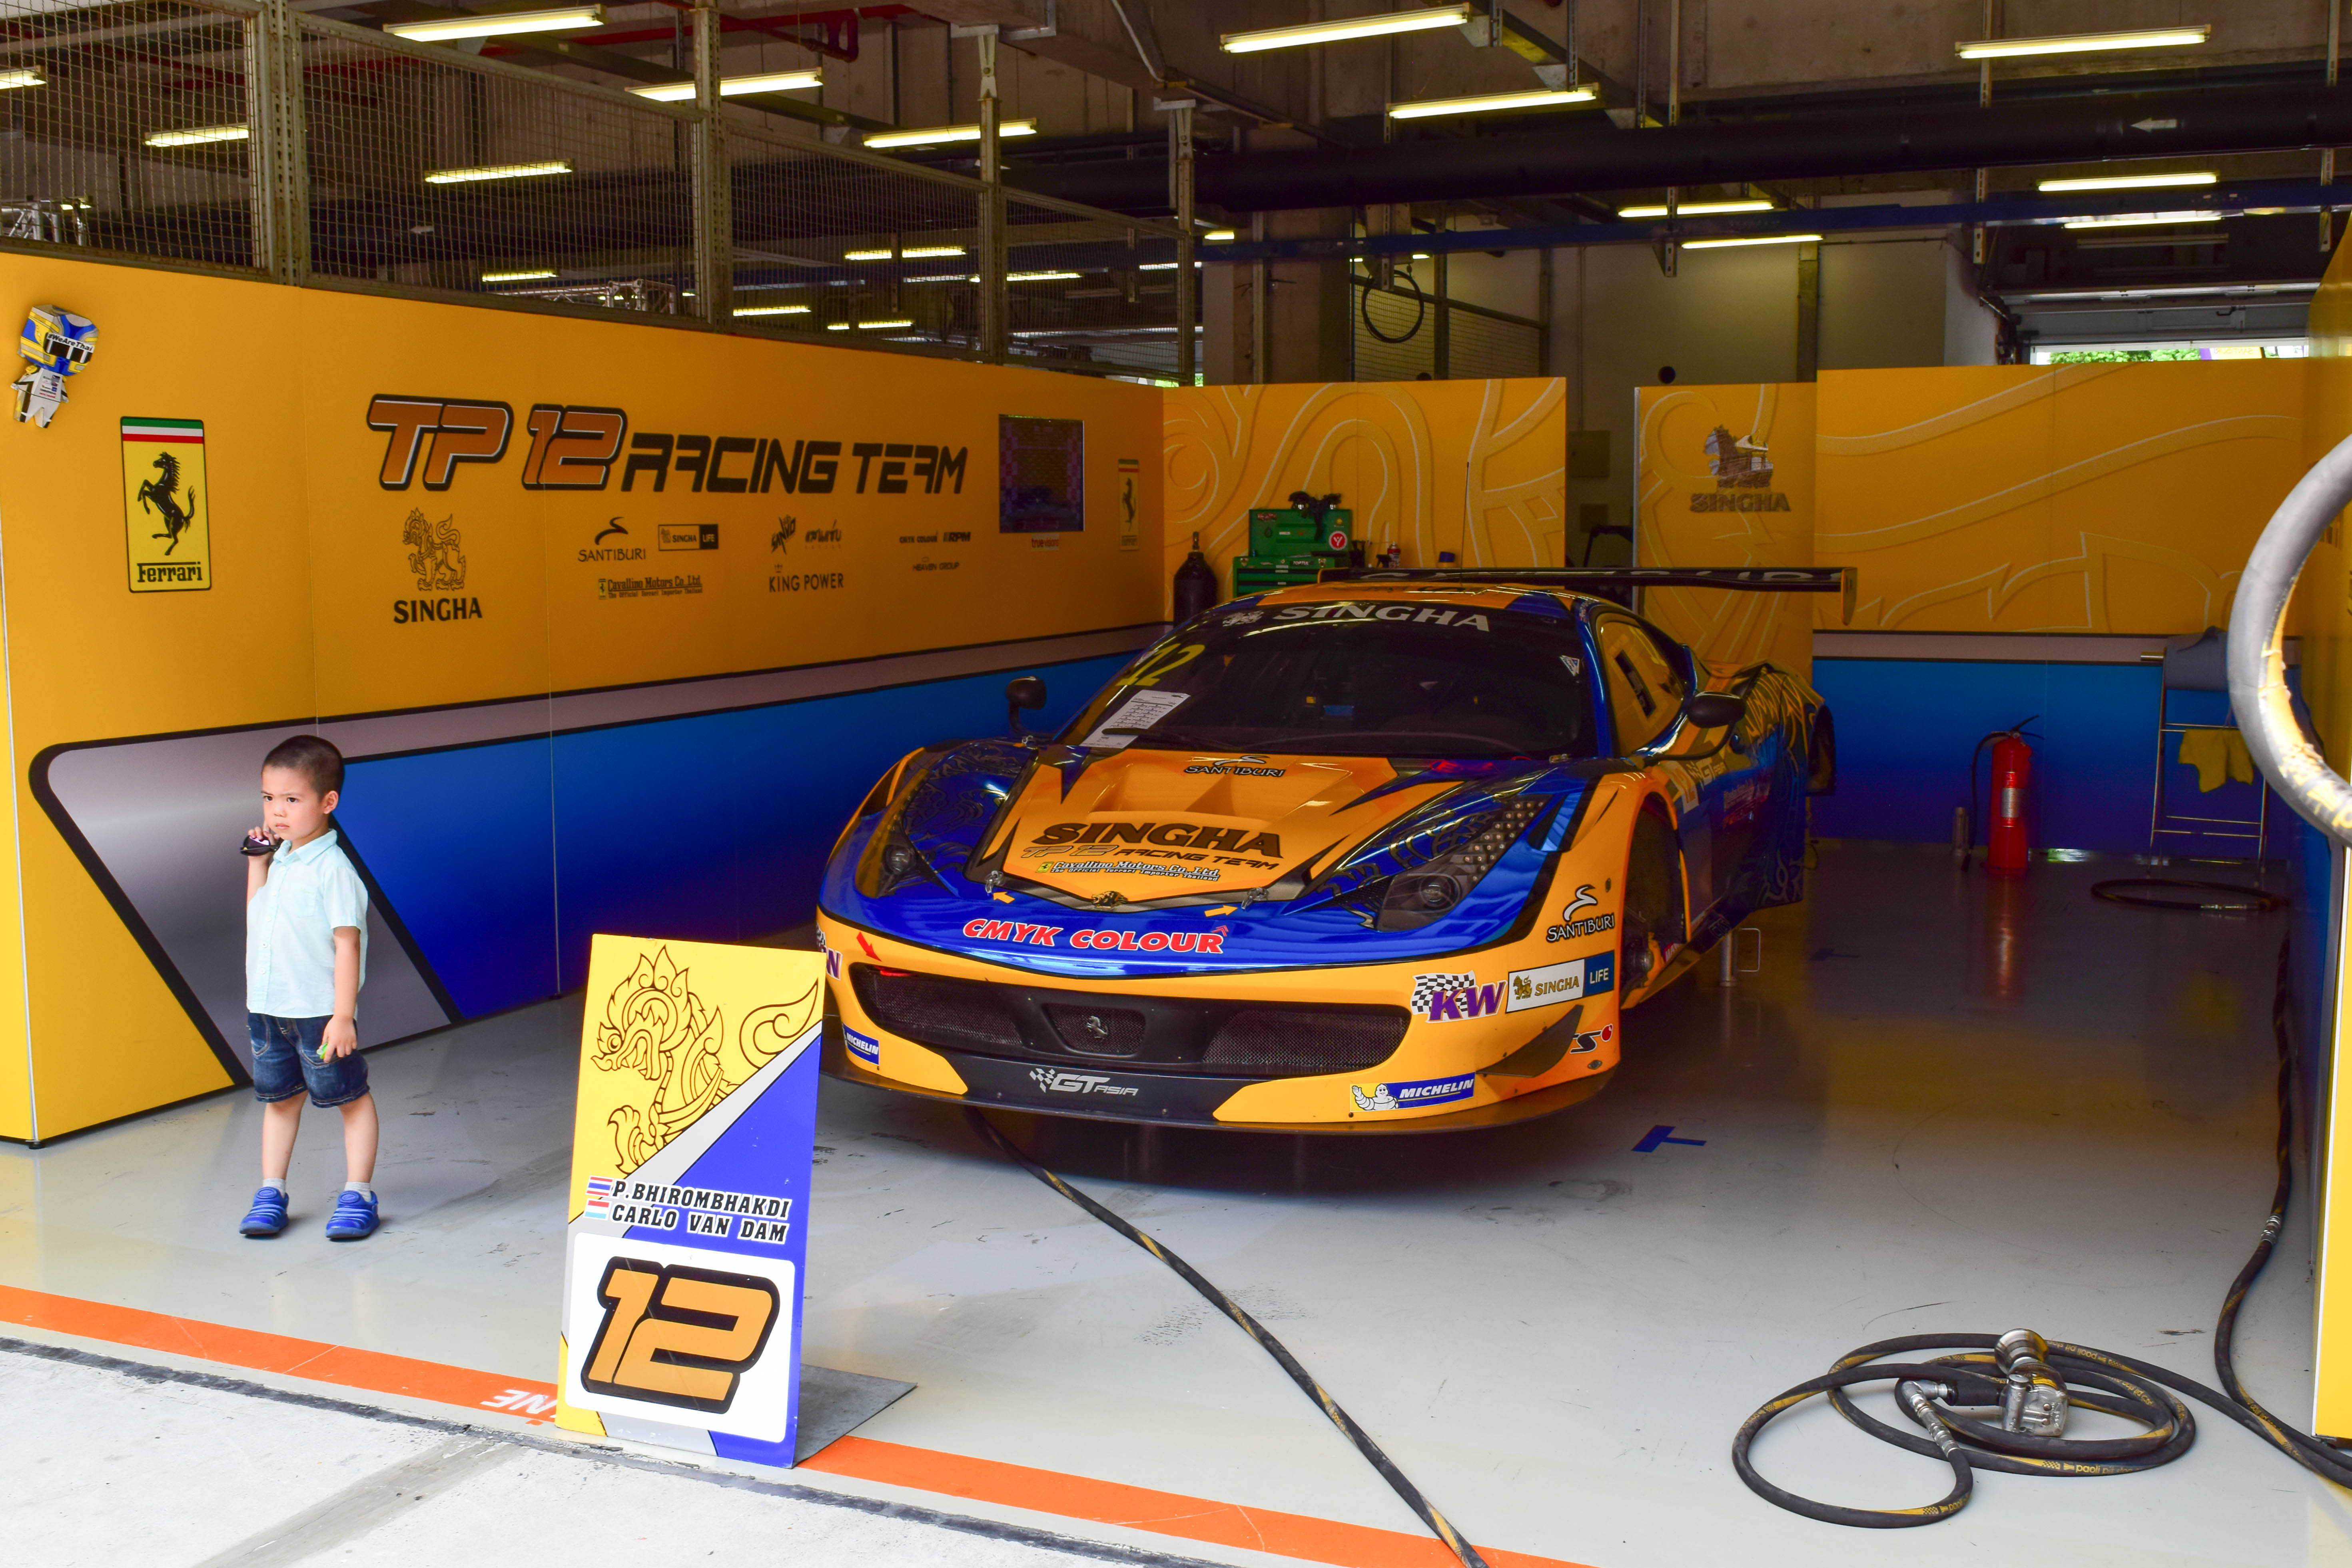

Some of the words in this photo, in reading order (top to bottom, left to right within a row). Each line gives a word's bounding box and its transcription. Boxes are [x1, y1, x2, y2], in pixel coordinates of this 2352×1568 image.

[48, 333, 93, 352] #WeAreThai
[367, 394, 514, 491] TP
[522, 404, 628, 490] 12
[621, 433, 841, 494] RACING
[852, 443, 968, 494] TEAM
[1690, 493, 1791, 512] SINGHA
[702, 534, 715, 542] LIFE
[578, 549, 646, 562] SANTIBURI
[137, 562, 202, 583] Ferrari
[769, 575, 800, 592] KING
[804, 573, 844, 590] POWER
[393, 597, 483, 623] SINGHA
[1273, 604, 1489, 632] SINGHA
[1184, 765, 1286, 777] SANTIBURI
[1031, 822, 1284, 858] SINGHA
[1021, 846, 1073, 858] TP
[1069, 845, 1118, 856] 12
[1115, 848, 1209, 861] RACING
[1212, 856, 1280, 870] TEAM
[1053, 861, 1114, 869] Cavallino
[1115, 861, 1166, 870] Motors
[963, 919, 1063, 946] CMYK
[1070, 930, 1223, 954] COLOUR
[1546, 914, 1615, 942] SANTIBURI
[1534, 976, 1580, 996] SINGHA
[1590, 967, 1609, 984] LIFE
[1428, 981, 1507, 1022] KW
[846, 1032, 879, 1055] MICHELIN
[1049, 1073, 1111, 1093] GT
[1399, 1078, 1474, 1098] MICHELIN
[612, 1181, 790, 1219] P.BHIROMBHAKDI
[612, 1204, 677, 1228] CARLO
[690, 1214, 730, 1235] VAN
[740, 1221, 787, 1242] DAM
[581, 1256, 780, 1414] 12
[2076, 1464, 2100, 1473] paoli
